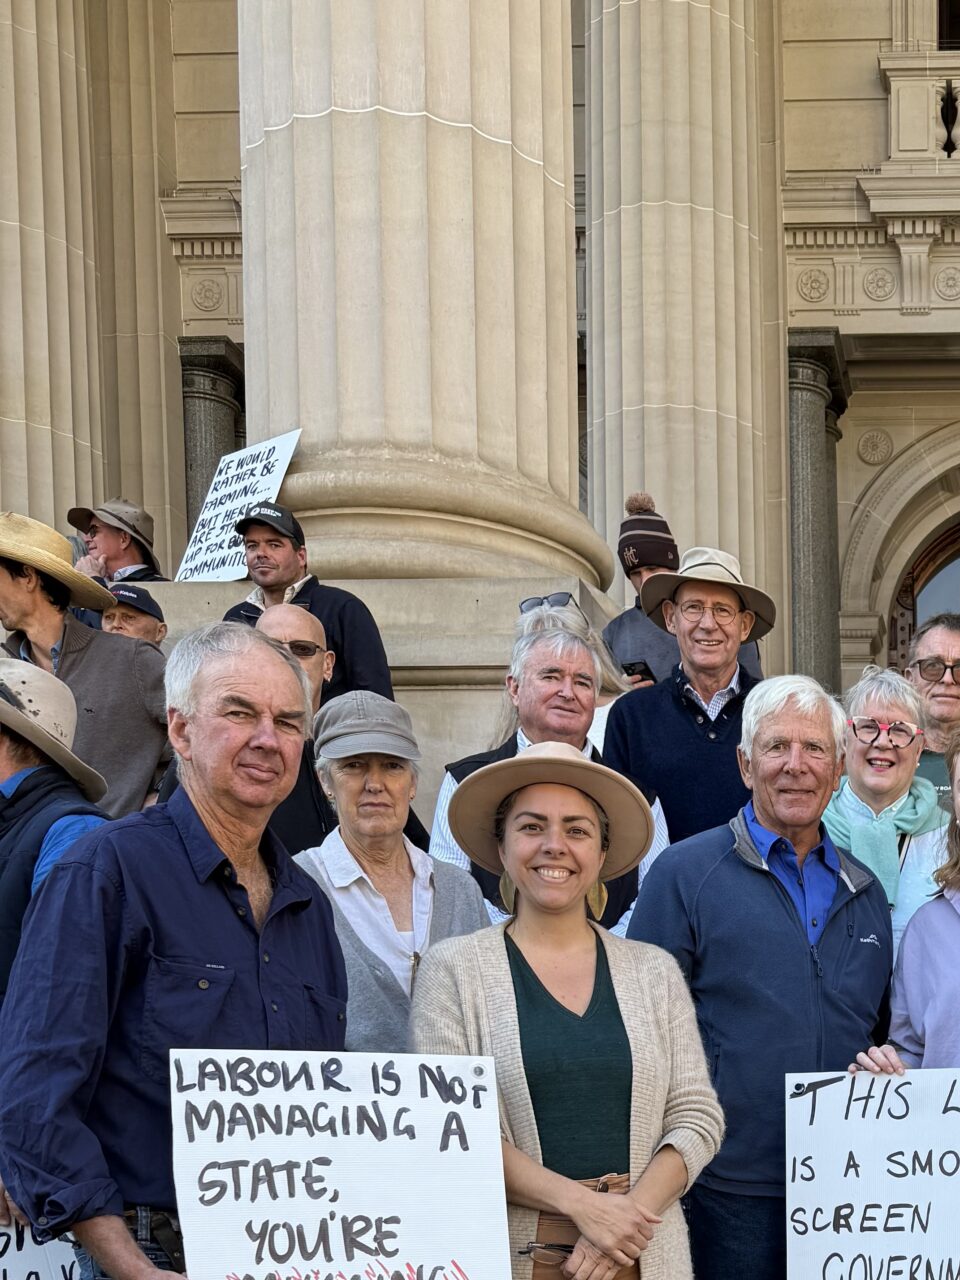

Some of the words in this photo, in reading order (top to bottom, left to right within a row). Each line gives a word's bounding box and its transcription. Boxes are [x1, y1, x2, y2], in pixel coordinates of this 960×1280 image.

[236, 446, 276, 471] WOULD
[211, 467, 257, 494] RATHER
[260, 459, 279, 477] BE
[190, 527, 216, 549] ARE
[196, 512, 222, 533] BUT
[185, 547, 202, 564] UP
[205, 539, 225, 556] FOR
[173, 1057, 352, 1097] LABOUR
[371, 1060, 401, 1097] IS
[419, 1063, 488, 1109] NOT
[790, 1076, 913, 1126] THIS
[184, 1099, 416, 1142] MANAGING
[439, 1111, 470, 1152] A
[198, 1156, 340, 1206] STATE,
[791, 1155, 816, 1183] IS
[844, 1151, 861, 1178] A
[790, 1201, 932, 1236] SCREEN
[244, 1210, 402, 1265] YOU'RE
